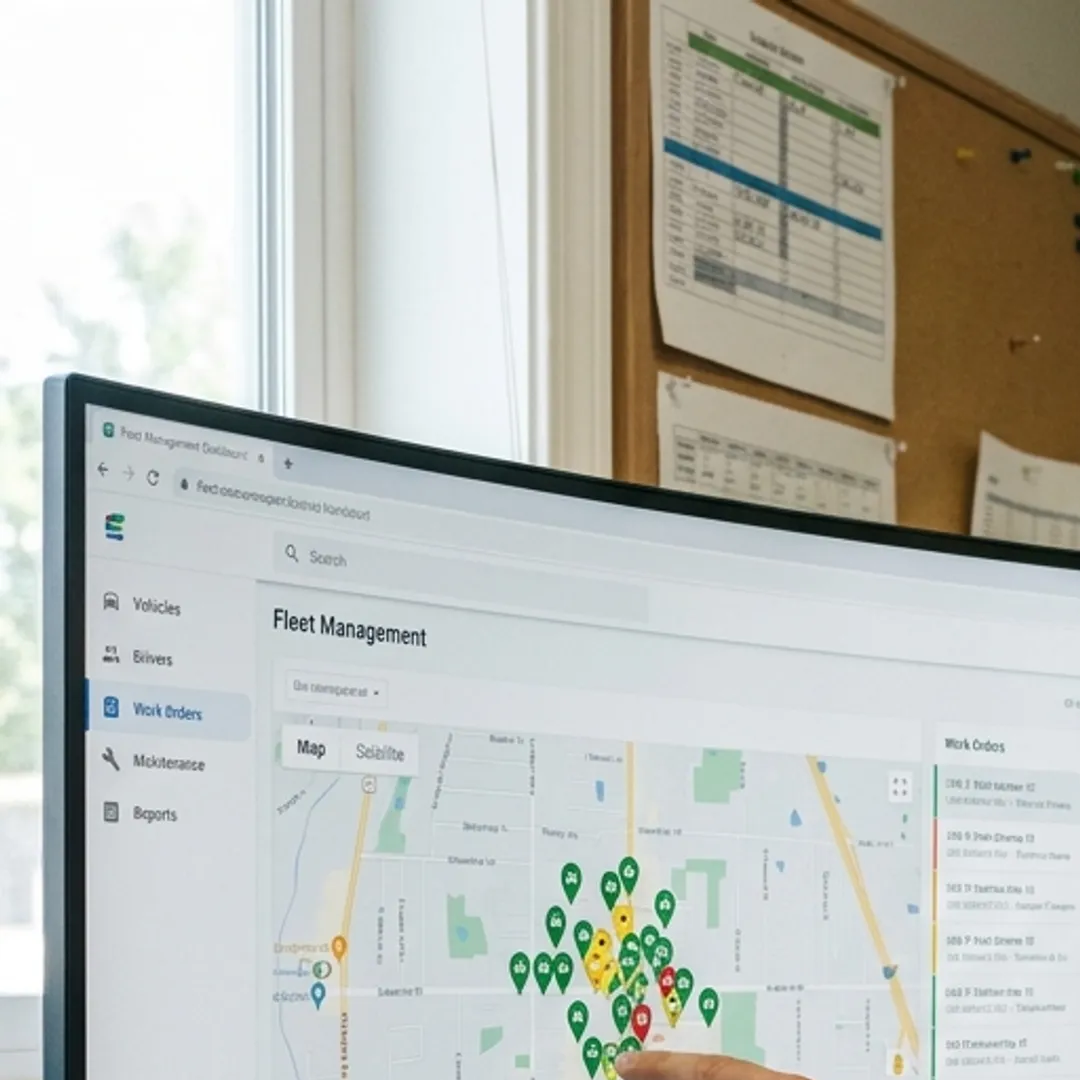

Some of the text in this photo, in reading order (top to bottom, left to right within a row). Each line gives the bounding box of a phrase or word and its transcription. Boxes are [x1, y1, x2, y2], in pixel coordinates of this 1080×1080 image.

[273, 608, 427, 647] Fleet Management
[132, 701, 203, 721] Work Orders
[296, 739, 326, 759] Map
